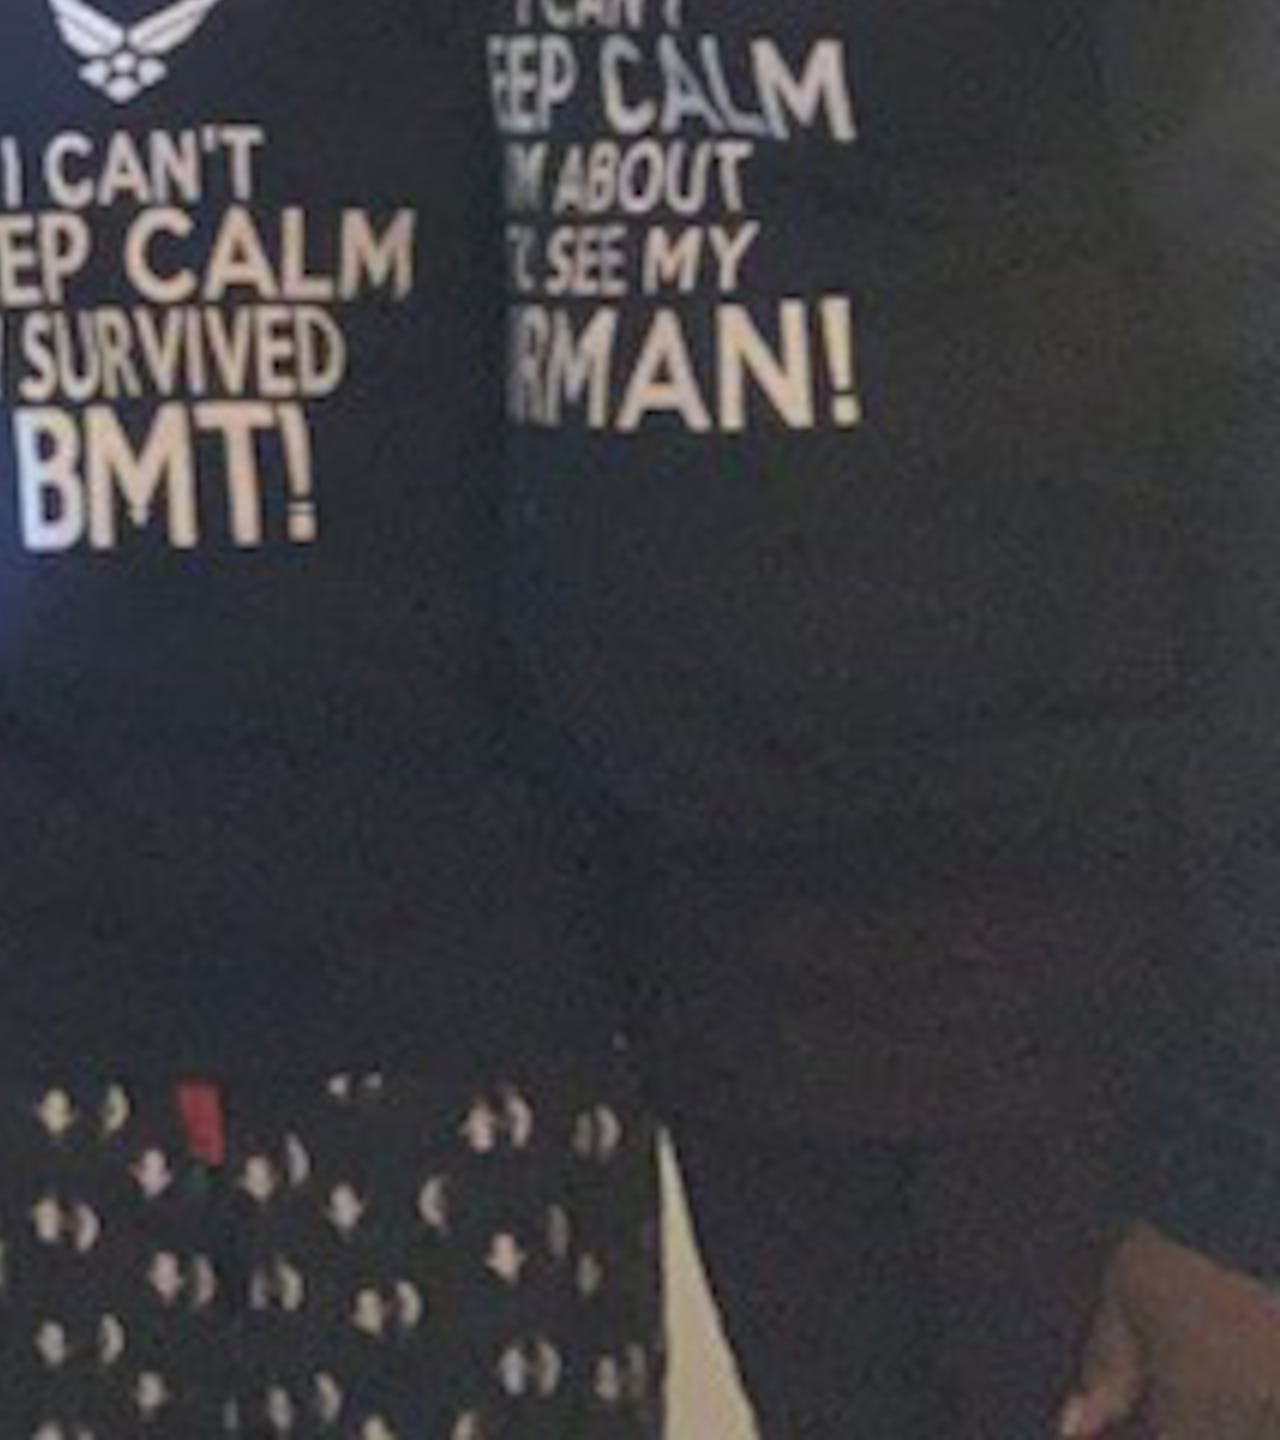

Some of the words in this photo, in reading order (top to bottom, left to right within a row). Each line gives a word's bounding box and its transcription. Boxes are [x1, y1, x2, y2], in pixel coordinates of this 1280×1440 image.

[600, 33, 857, 142] CALM
[0, 135, 23, 208] I
[42, 123, 265, 210] CAN'T
[551, 141, 754, 215] ABOUT
[124, 204, 417, 304] CALM
[545, 223, 628, 296] SEE
[643, 221, 760, 295] MY
[18, 304, 345, 402] SURVIVED
[13, 400, 317, 553] BMT!
